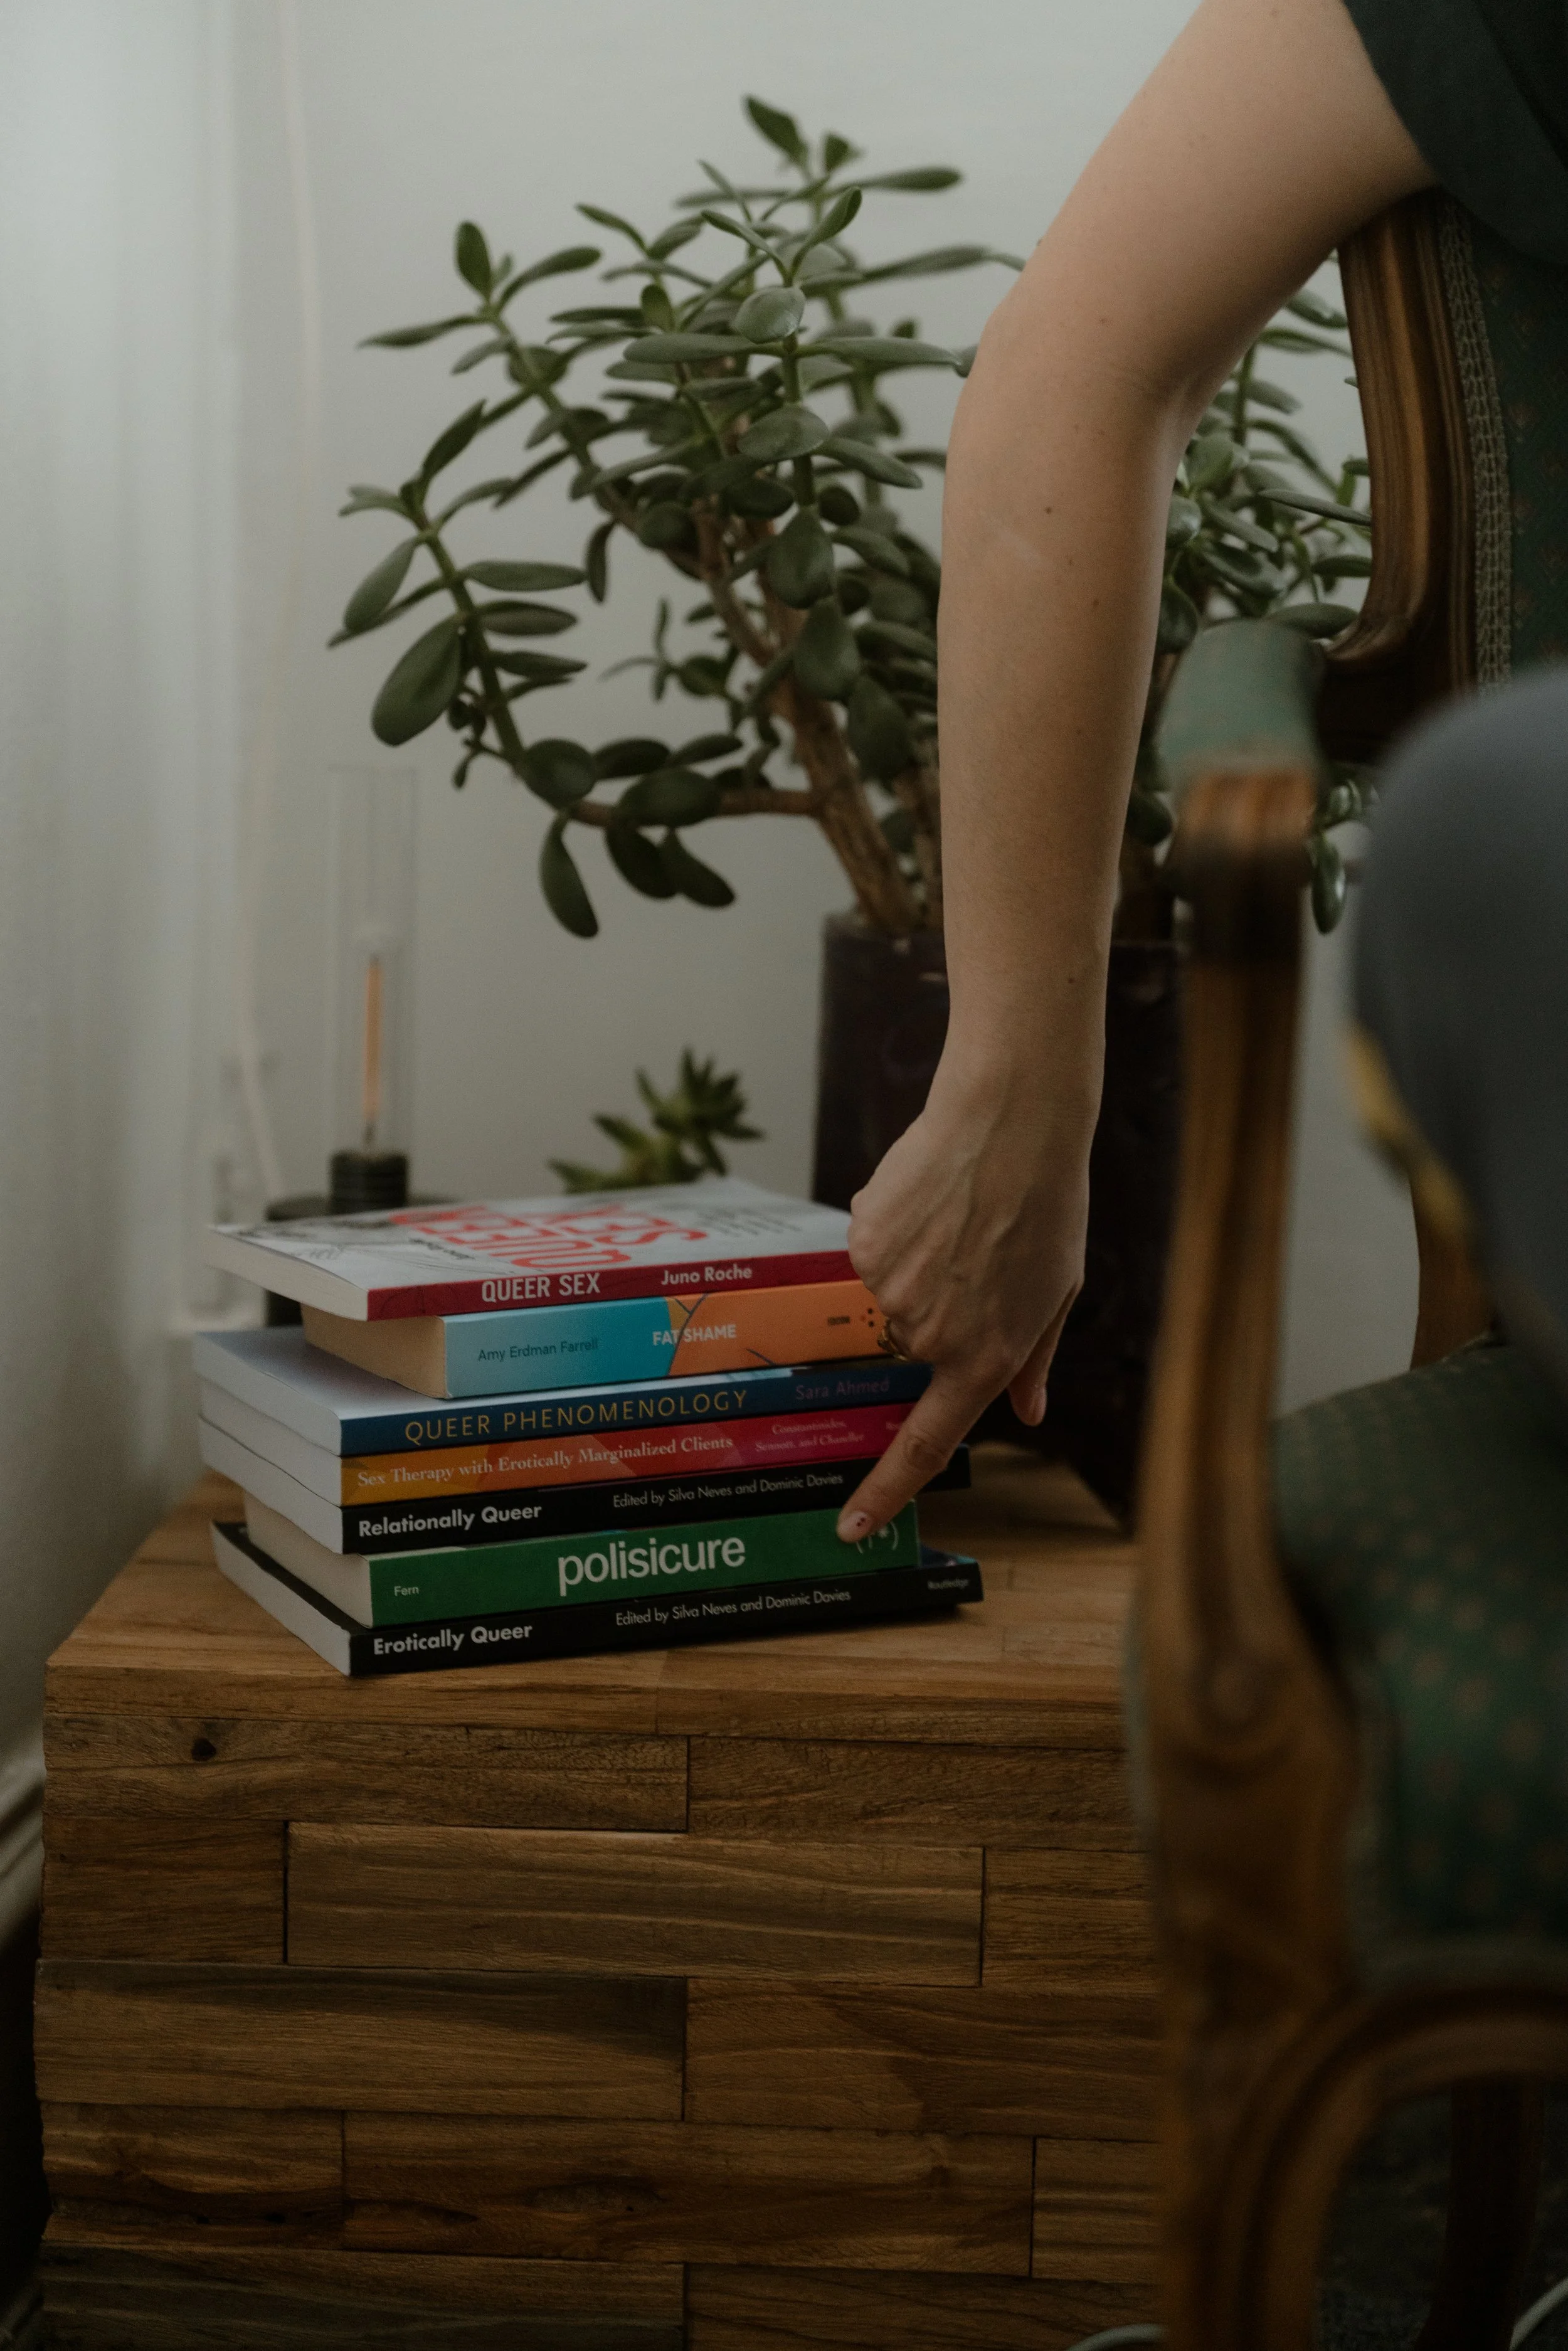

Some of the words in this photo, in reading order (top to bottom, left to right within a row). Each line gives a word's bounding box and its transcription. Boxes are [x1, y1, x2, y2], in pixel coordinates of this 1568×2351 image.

[482, 1274, 550, 1303] QUEER
[558, 1272, 600, 1296] SEX
[661, 1269, 701, 1286] Juno
[704, 1263, 752, 1282] Roche
[478, 1347, 504, 1363] Amy
[509, 1341, 557, 1359] Erdman
[561, 1338, 599, 1354] Farrell
[652, 1330, 679, 1346] FAT
[683, 1325, 736, 1342] SHAME
[795, 1384, 829, 1400] Sara
[836, 1376, 890, 1396] Ahmed
[405, 1414, 490, 1445] QUEER
[504, 1390, 747, 1432] PHENOMENOLOGY
[358, 1472, 386, 1487] Sex
[390, 1464, 455, 1487] Therapy
[459, 1460, 493, 1476] with
[497, 1448, 574, 1471] Erotically
[579, 1441, 676, 1465] Marginalized
[681, 1435, 733, 1453] Clients
[613, 1491, 649, 1507] Edited
[651, 1490, 665, 1506] by
[668, 1487, 694, 1501] Silva
[698, 1483, 731, 1499] Neves
[736, 1478, 756, 1495] and
[760, 1477, 804, 1492] Dominic
[807, 1473, 843, 1487] Davies
[359, 1508, 475, 1537] Relationally
[481, 1505, 542, 1524] Queer
[558, 1536, 746, 1596] polisicure
[394, 1584, 419, 1596] Fern
[616, 1611, 652, 1626] Edited
[654, 1610, 669, 1625] by
[672, 1605, 699, 1619] Silva
[702, 1601, 736, 1616] Neves
[741, 1597, 763, 1612] and
[765, 1593, 810, 1610] Dominic
[813, 1589, 851, 1605] Davies
[374, 1628, 465, 1655] Erotically
[470, 1625, 532, 1643] Queer
